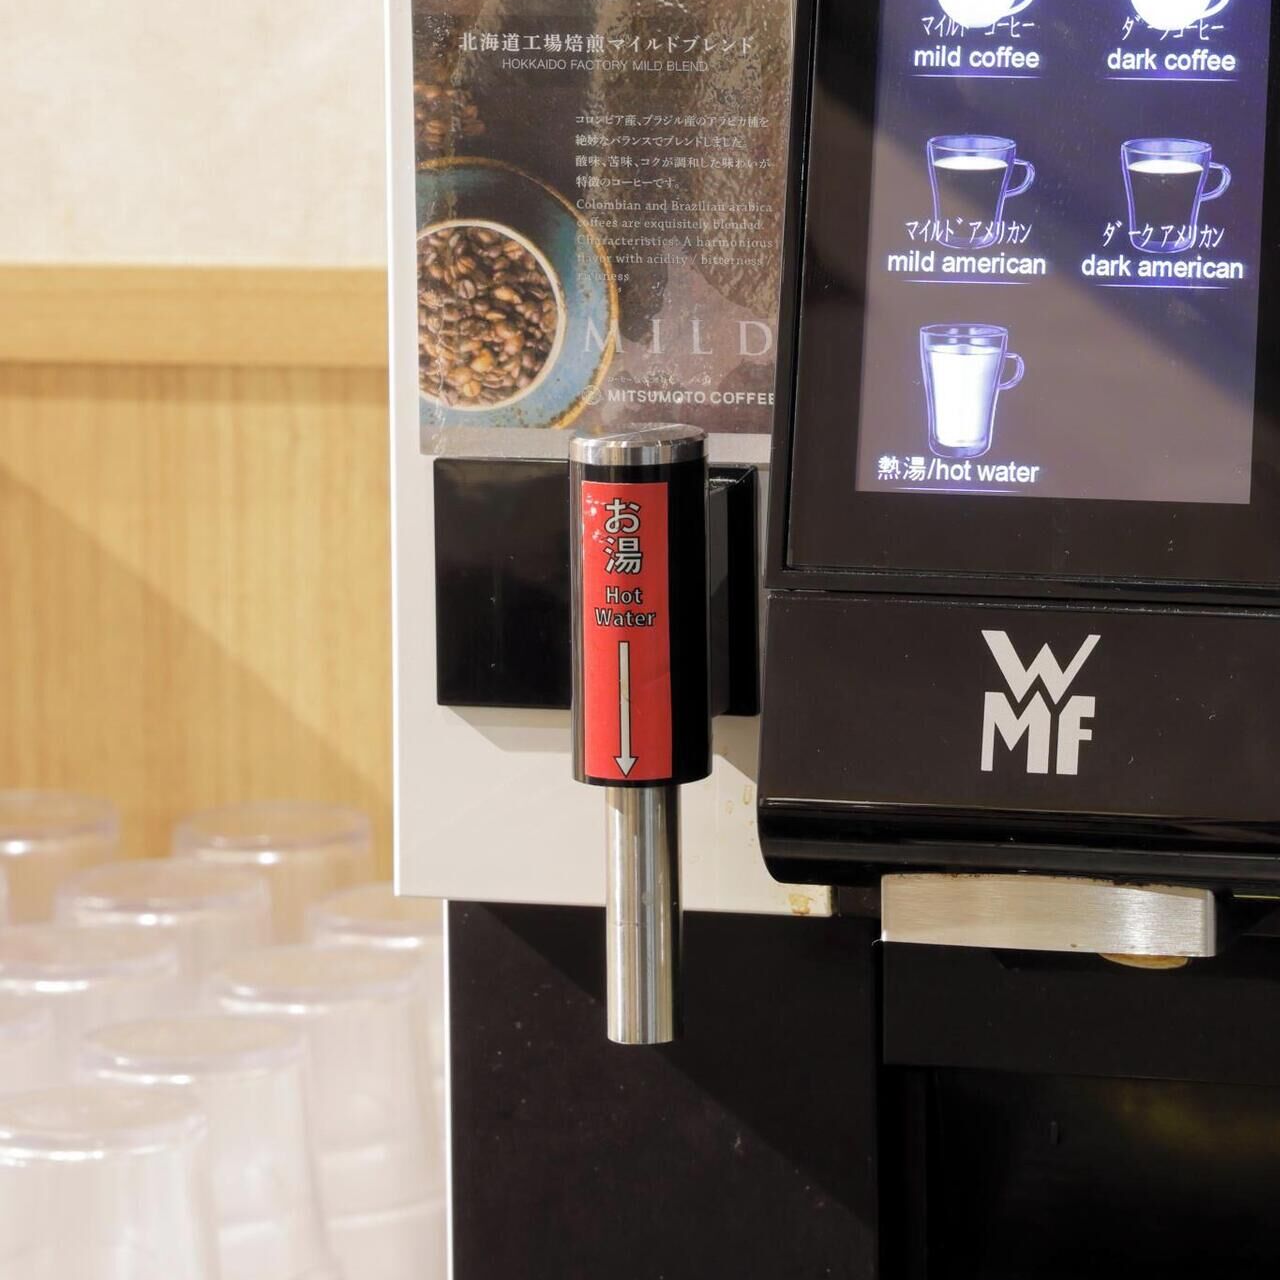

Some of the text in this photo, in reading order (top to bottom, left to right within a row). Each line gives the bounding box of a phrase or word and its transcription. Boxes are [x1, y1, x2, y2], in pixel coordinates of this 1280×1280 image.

[458, 32, 754, 54] 北海道工場焙煎マイルドブレンド
[502, 59, 708, 72] HOKKAIDO FACTORY MILD BLEND
[914, 45, 1040, 68] mild coffee
[1108, 48, 1236, 71] dark coffee
[576, 176, 679, 189] 特徴のコーヒーです。
[577, 199, 772, 213] Colombian and Brazilian arabica
[577, 216, 617, 228] coffees
[622, 219, 640, 228] are
[644, 219, 709, 231] exquisitely
[577, 235, 772, 248] Characteristics: A harmonious
[577, 253, 611, 264] flavor
[617, 253, 643, 264] with
[647, 254, 688, 266] acidity
[701, 255, 763, 266] bitterness
[888, 251, 1046, 274] mild american
[1081, 254, 1244, 278] dark american
[583, 318, 773, 356] MILD
[608, 390, 706, 404] MITSUMOTO
[878, 456, 1040, 483] 熱湯/hot water
[603, 498, 643, 574] お湯
[605, 586, 643, 604] Hot
[595, 607, 656, 626] Water
[981, 630, 1101, 775] WMF
